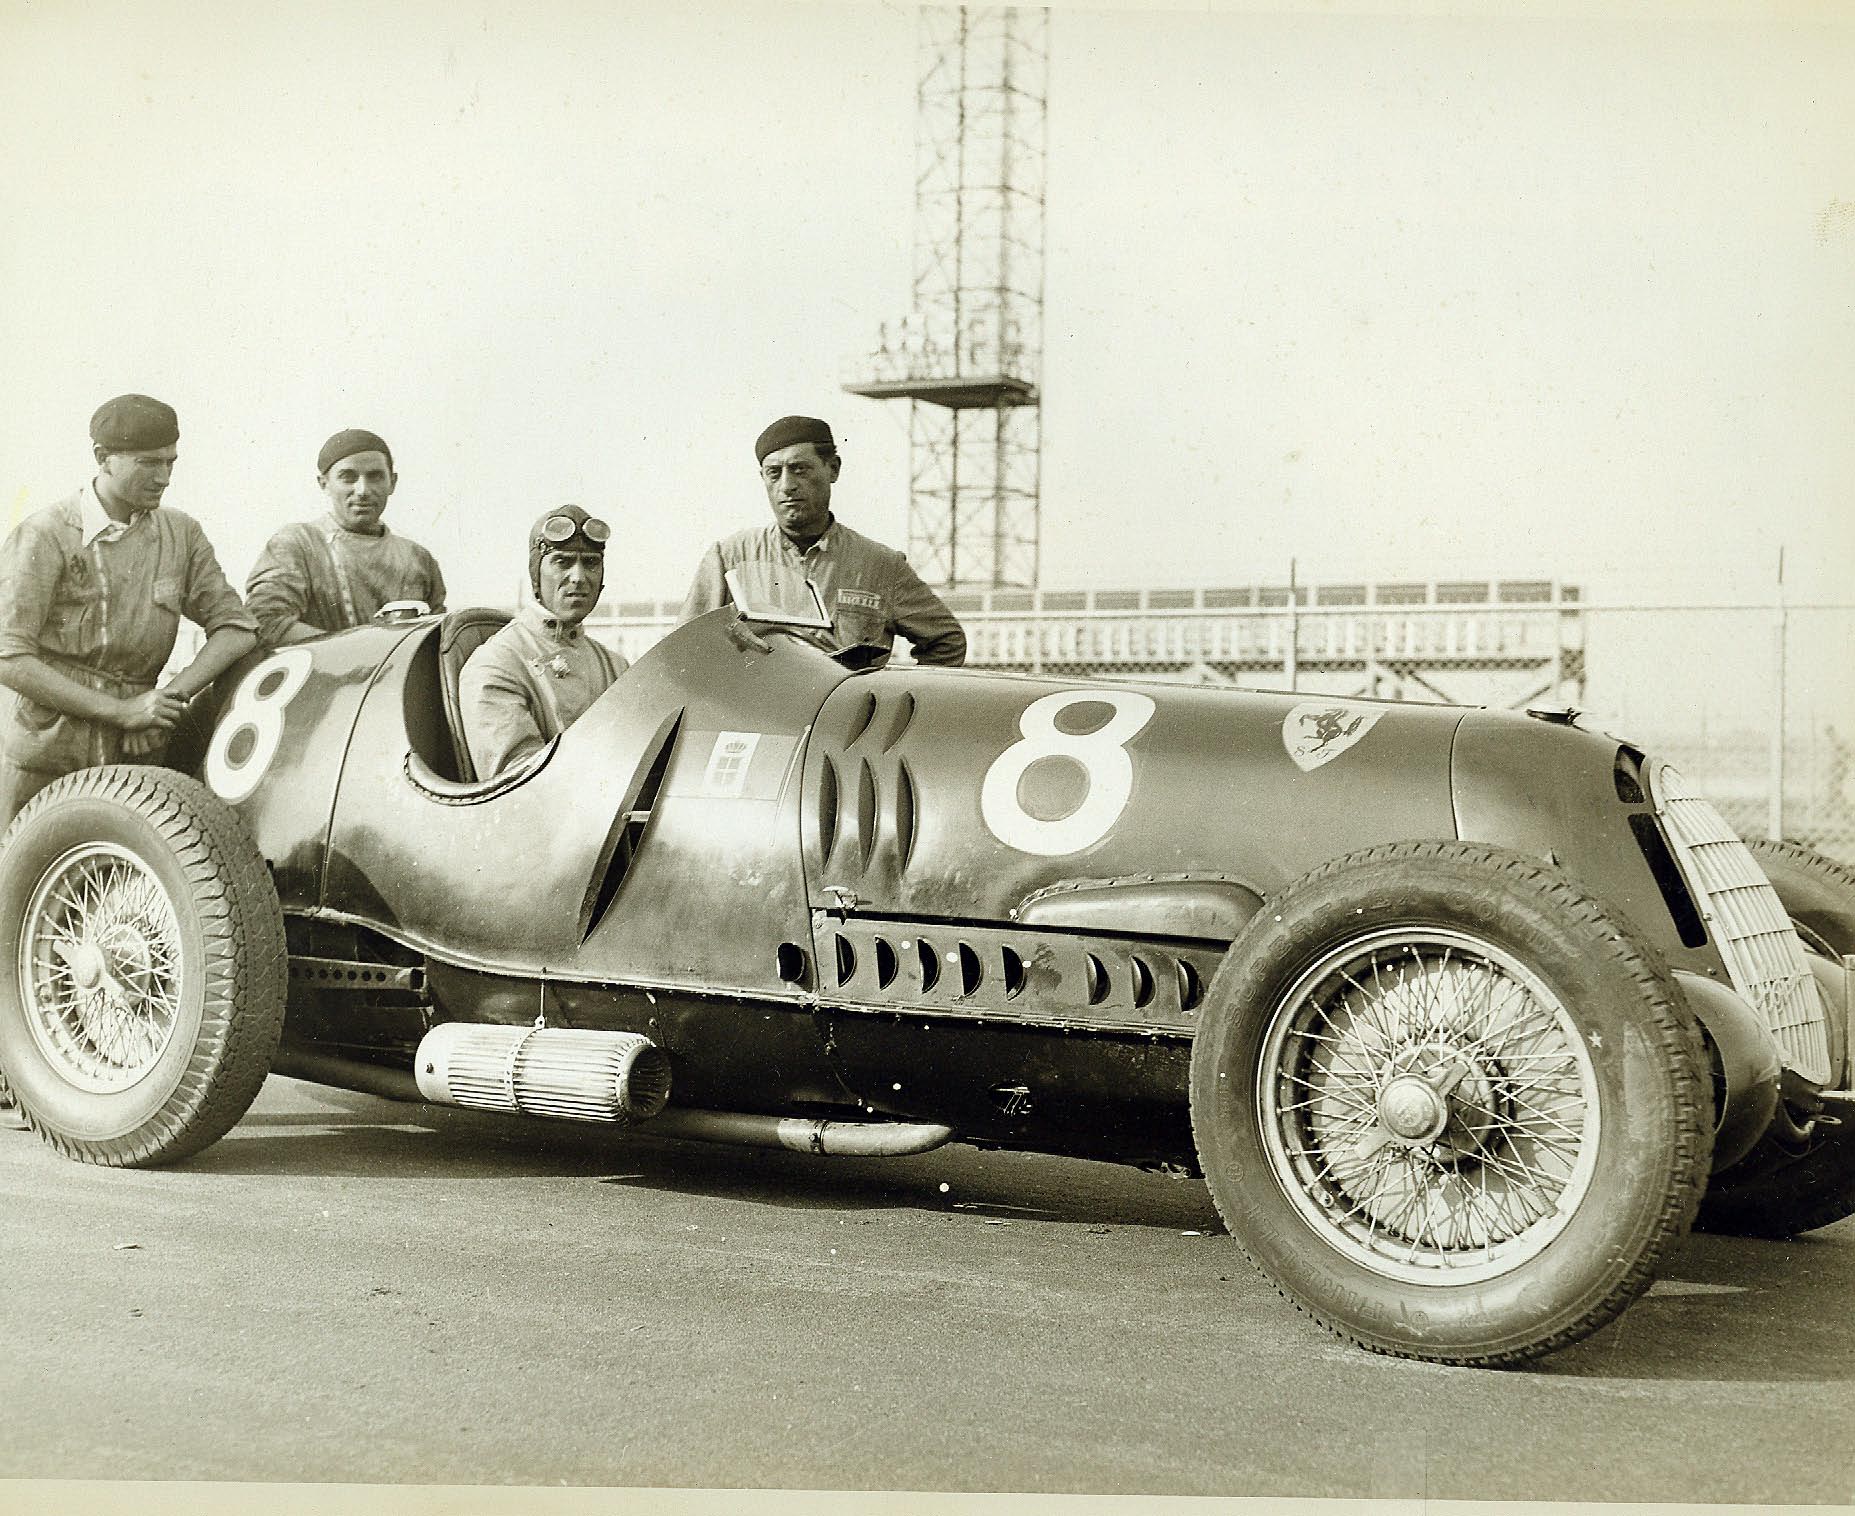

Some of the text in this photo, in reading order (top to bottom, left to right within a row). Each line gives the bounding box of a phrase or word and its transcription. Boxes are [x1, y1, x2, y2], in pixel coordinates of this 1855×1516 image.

[206, 649, 313, 803] 8
[982, 691, 1156, 855] 8
[1246, 1203, 1384, 1321] PIRELLI
